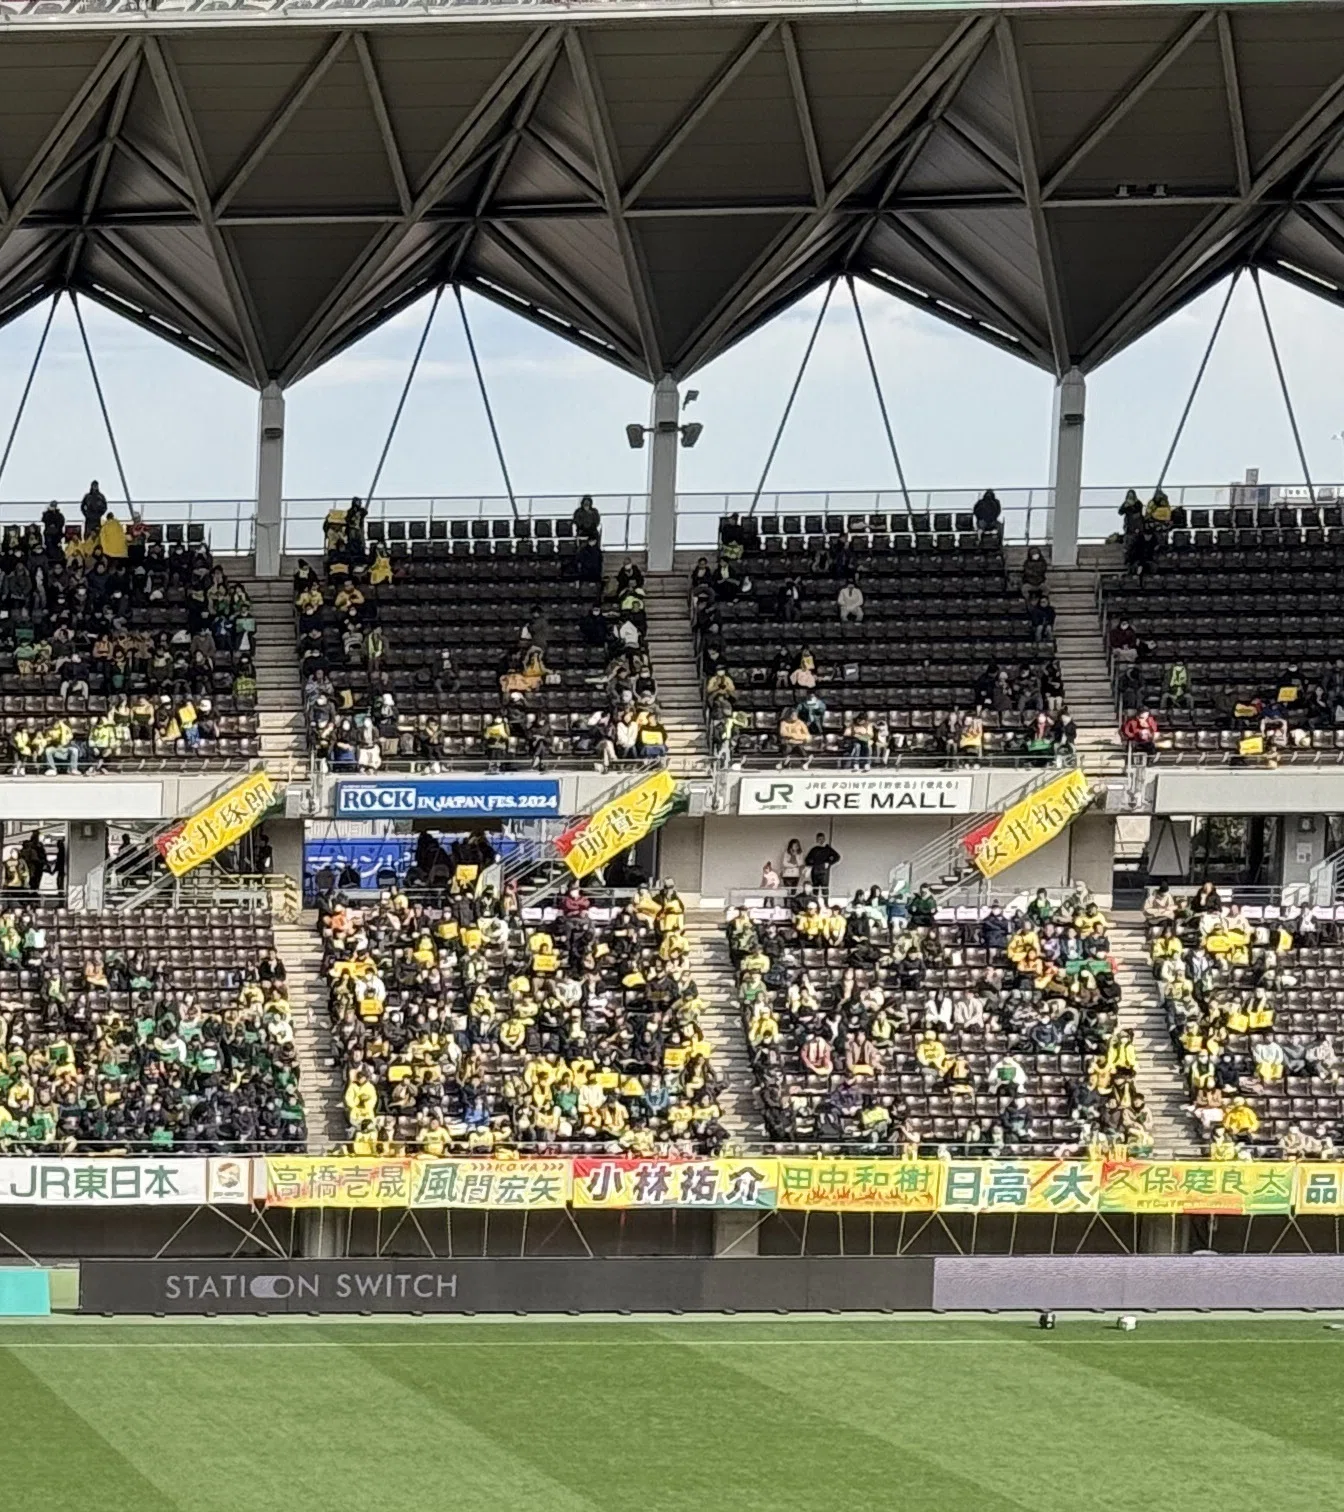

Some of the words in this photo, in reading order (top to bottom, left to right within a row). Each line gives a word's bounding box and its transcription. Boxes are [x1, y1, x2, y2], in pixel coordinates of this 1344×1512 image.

[342, 789, 414, 810] ROCK
[435, 795, 491, 812] JAPAN
[755, 784, 794, 804] JR
[804, 792, 861, 810] JRE
[870, 792, 957, 810] MALL
[9, 1164, 181, 1200] JR東日本
[415, 1162, 563, 1204] 風間宏矢
[586, 1164, 766, 1202] 小林祐介
[781, 1165, 934, 1193] 田中和樹
[1104, 1166, 1290, 1197] 久保庭良太
[335, 1273, 458, 1299] SWITCH
